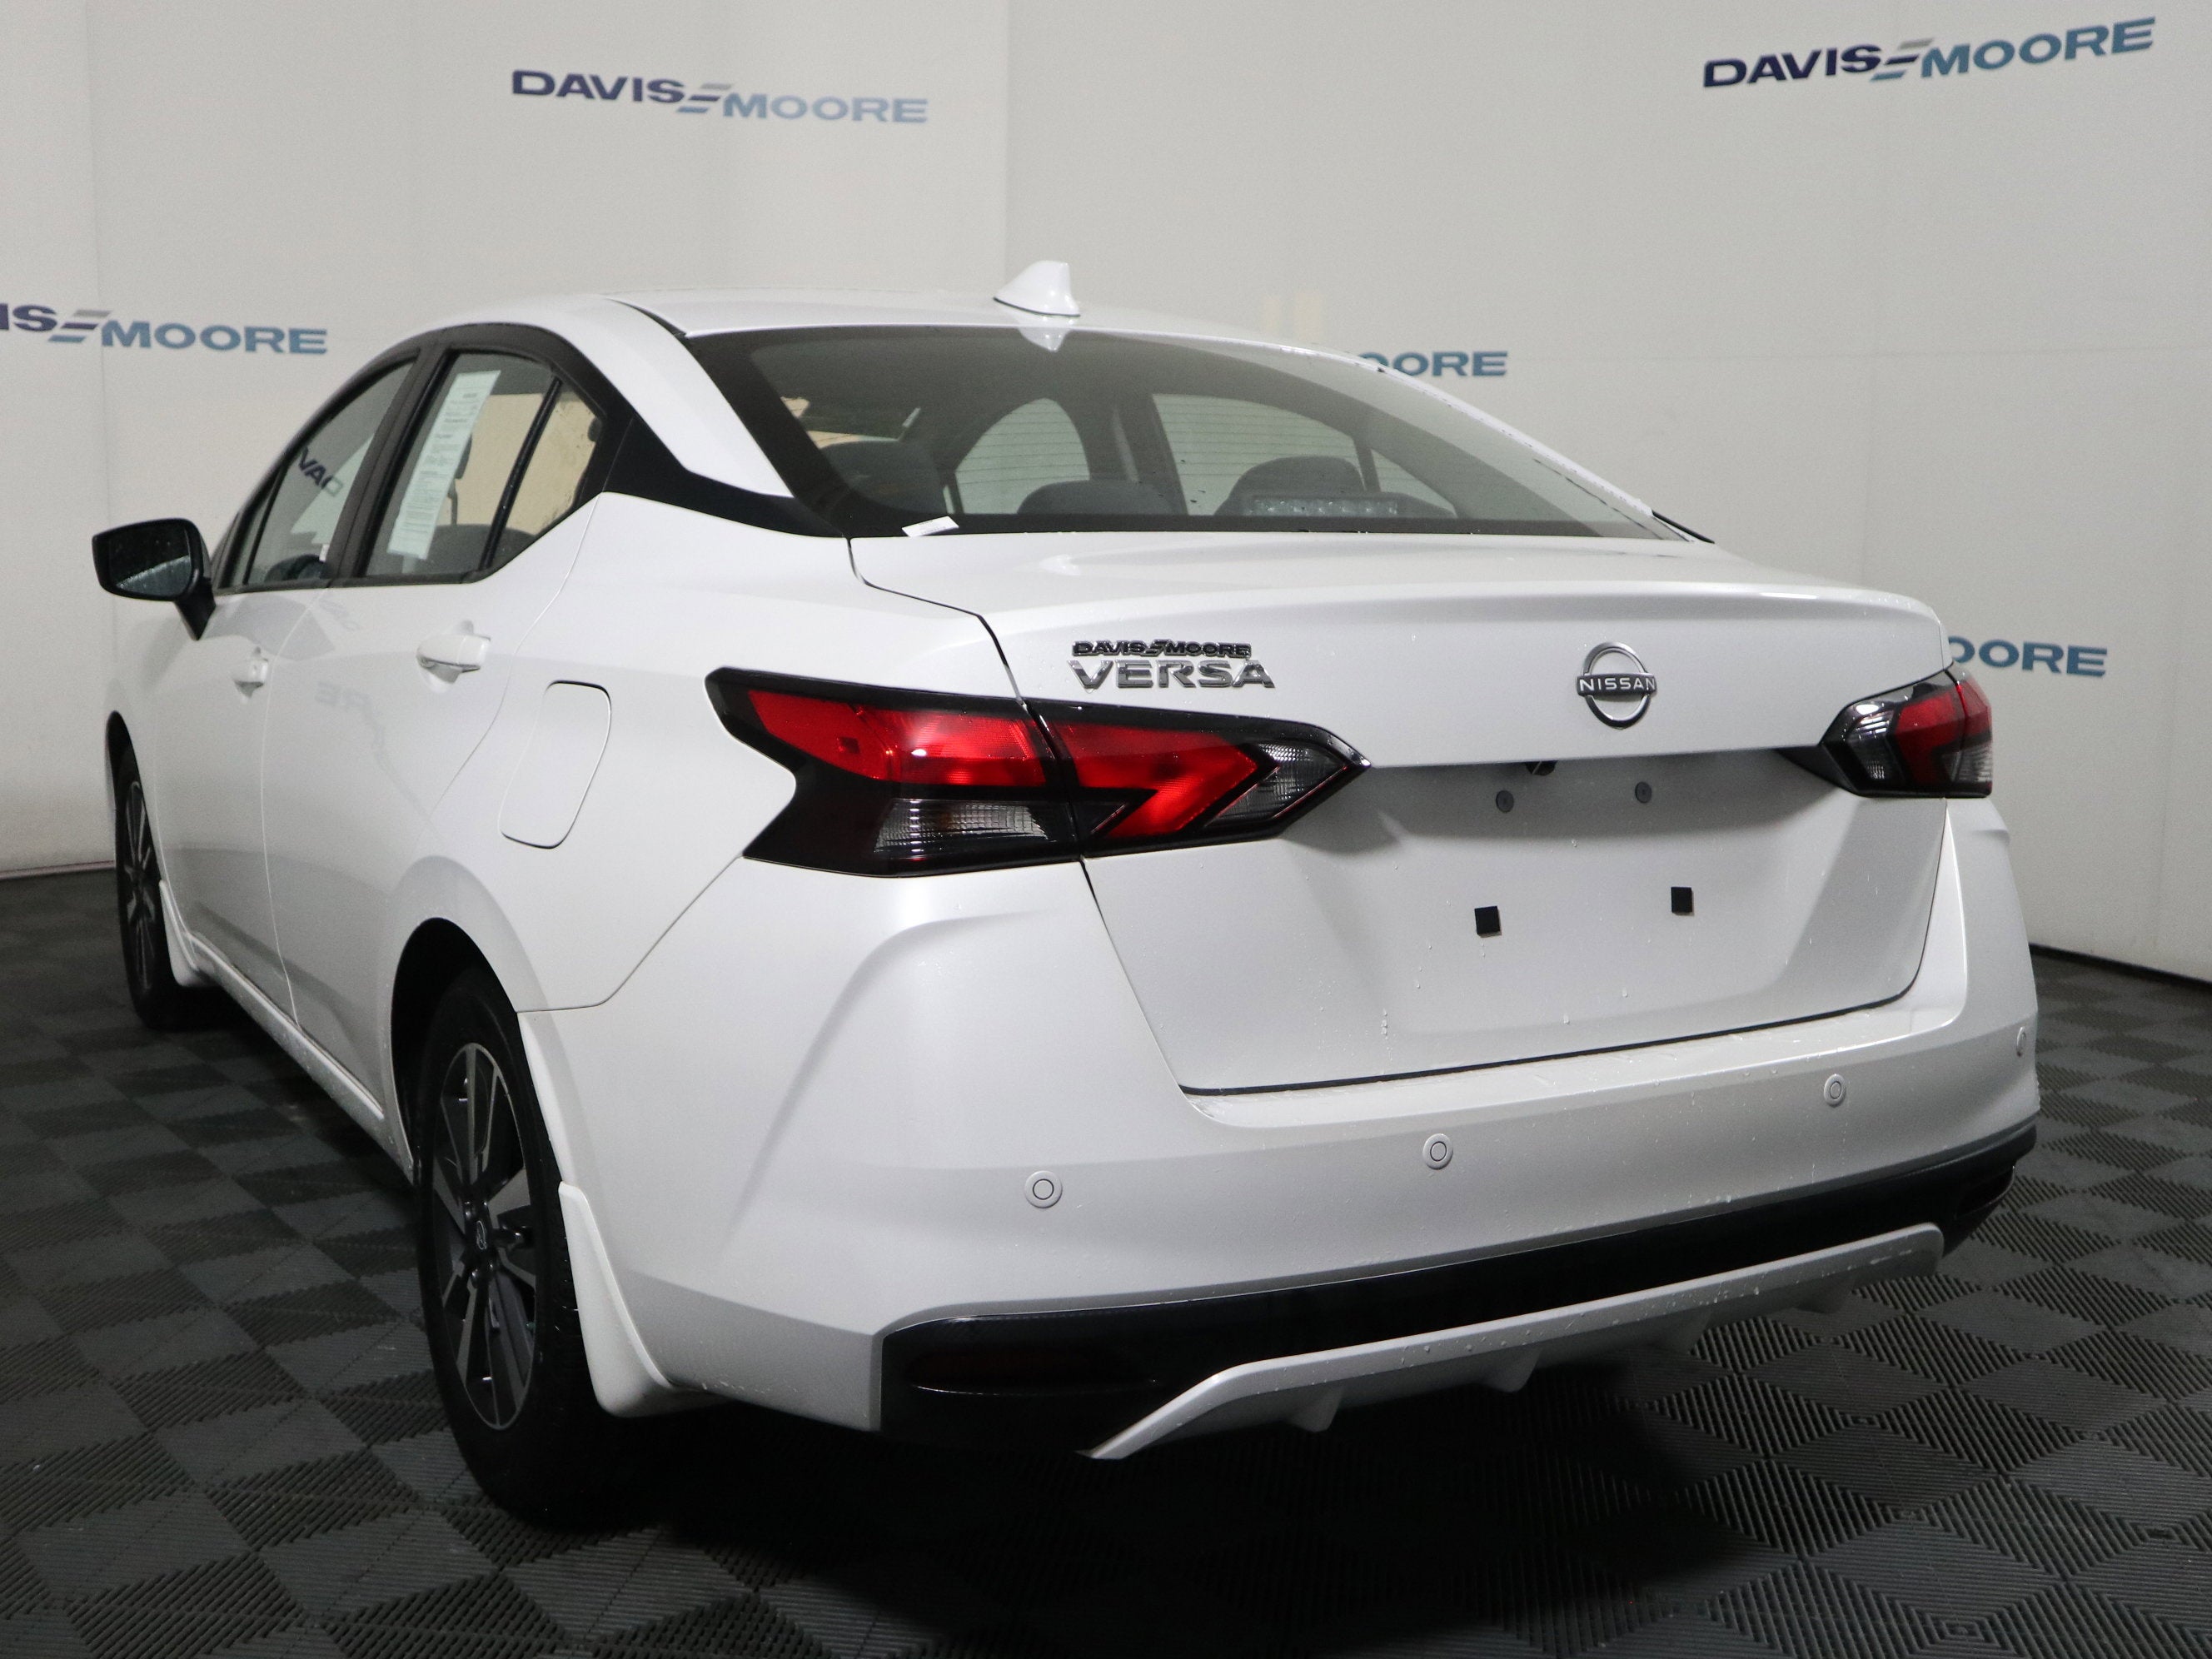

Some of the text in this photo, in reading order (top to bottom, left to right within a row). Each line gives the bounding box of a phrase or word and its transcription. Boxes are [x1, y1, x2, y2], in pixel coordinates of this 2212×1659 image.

[1703, 17, 2155, 87] DAVIS MOORE
[511, 70, 929, 123] DAVIS MOORE
[101, 320, 327, 354] MOORE
[1072, 640, 1252, 659] DAVIS MOORE
[1067, 660, 1276, 689] VERSA
[1579, 677, 1656, 692] NISSAN
